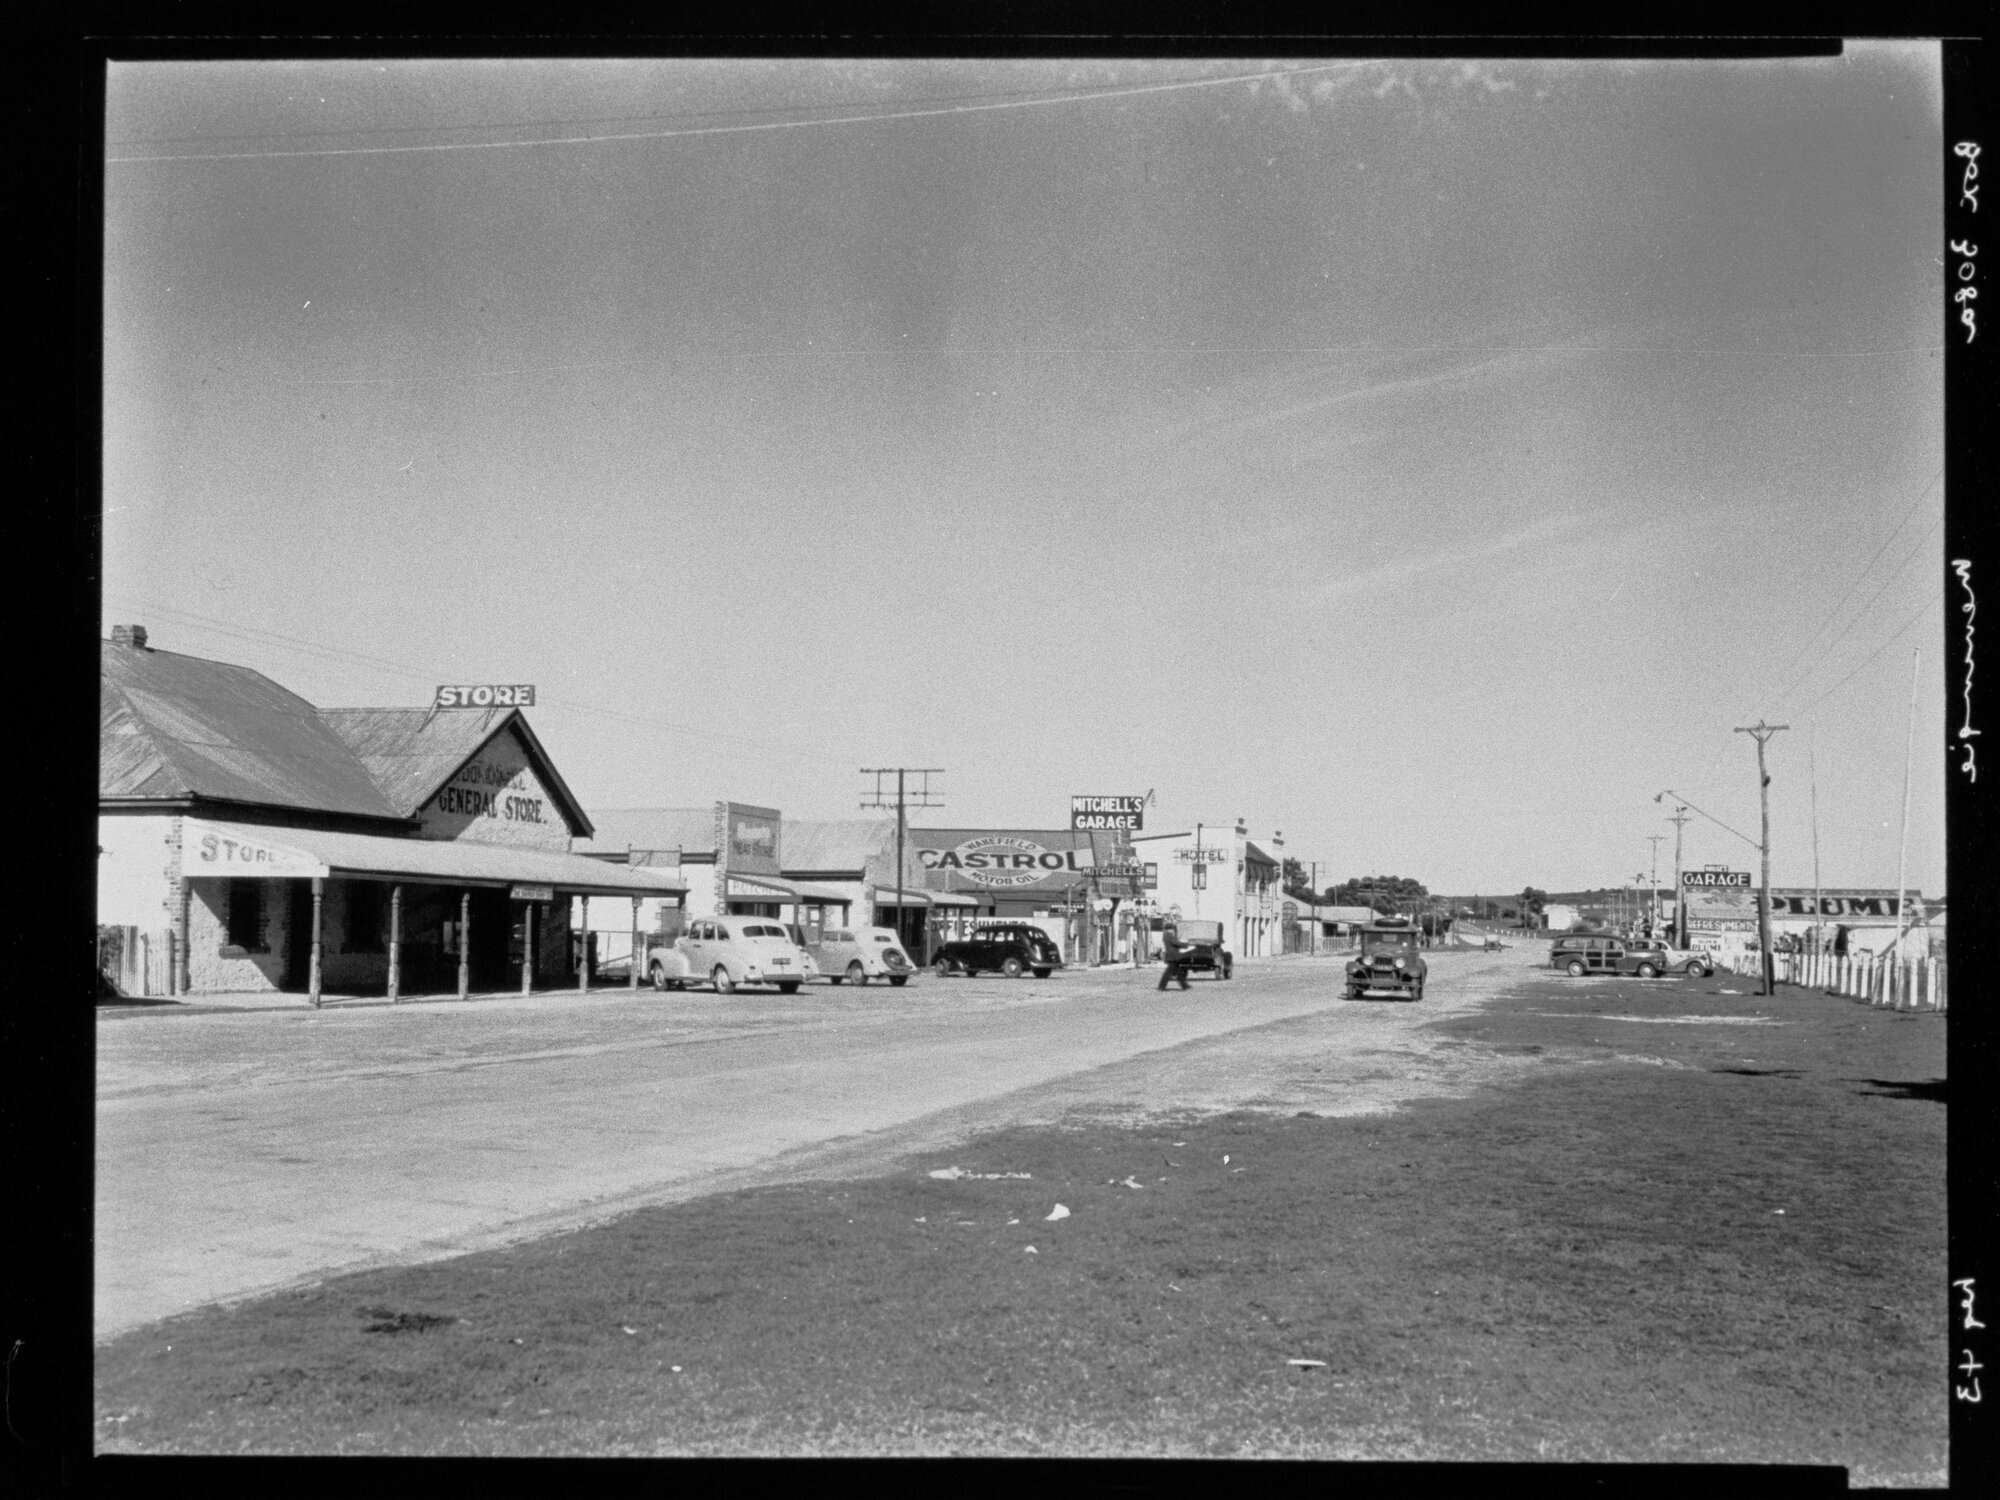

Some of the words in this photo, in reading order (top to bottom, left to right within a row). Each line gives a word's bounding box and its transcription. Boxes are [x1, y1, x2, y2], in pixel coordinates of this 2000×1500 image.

[439, 686, 530, 705] STORE
[439, 787, 498, 819] GENERAL
[1072, 797, 1142, 813] MITCHELL'S
[1075, 815, 1138, 829] GARAGE
[963, 837, 1037, 851] WAKEFIELD
[918, 849, 1083, 872] CASTROL
[1181, 850, 1225, 861] HOTEL
[971, 871, 1013, 886] MOTOR
[1015, 873, 1039, 884] OIL
[1683, 873, 1749, 886] GARAGE
